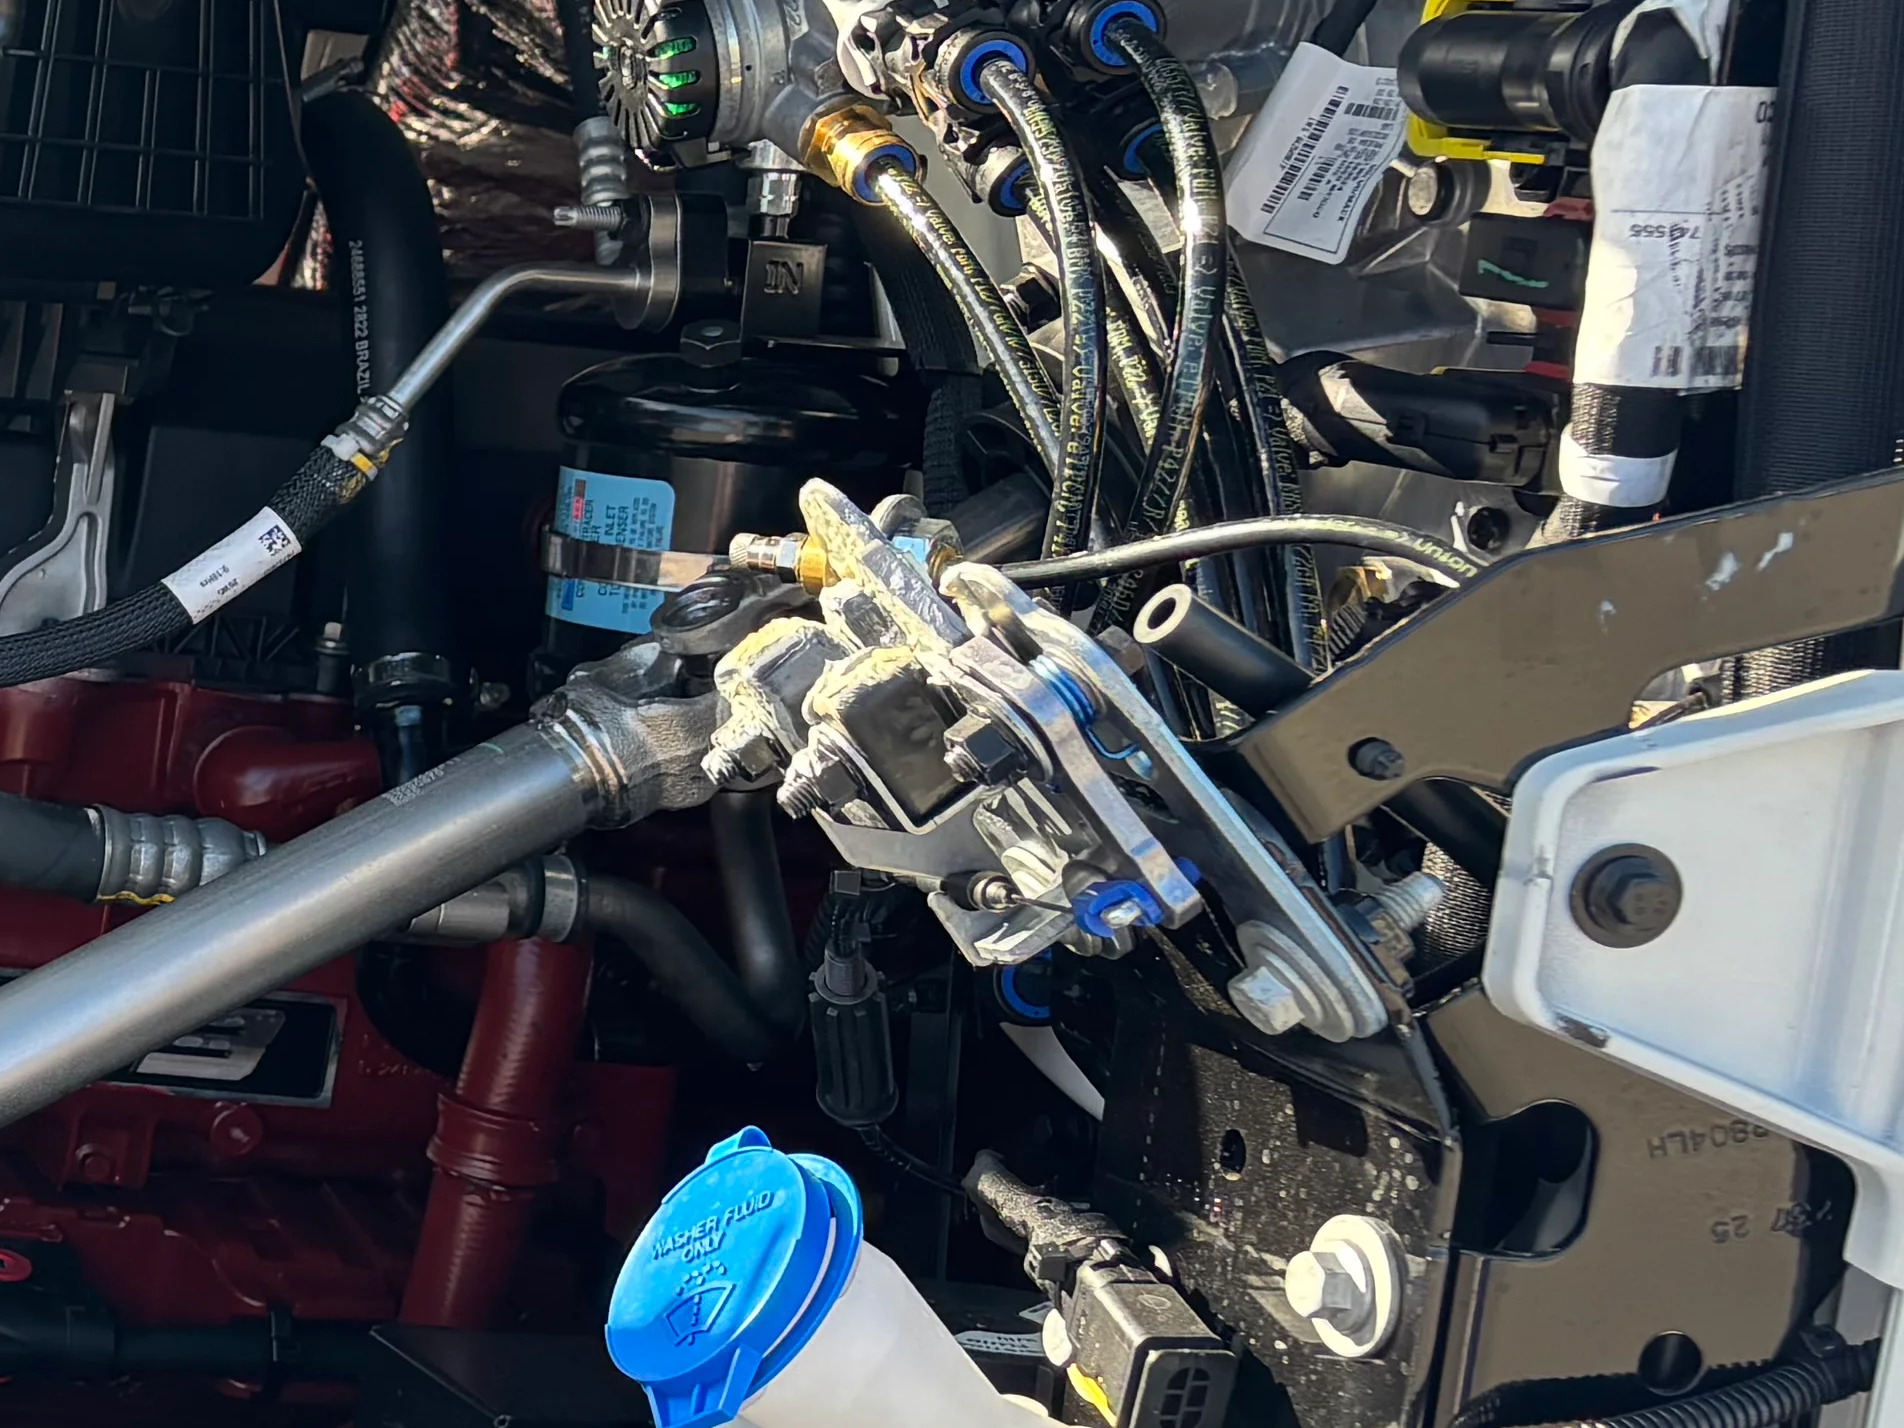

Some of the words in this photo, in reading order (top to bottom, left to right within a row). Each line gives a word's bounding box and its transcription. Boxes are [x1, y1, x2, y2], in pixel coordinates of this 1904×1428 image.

[765, 260, 804, 294] IN
[355, 340, 370, 394] BRAZIL
[653, 1216, 720, 1260] WASHER
[723, 1190, 774, 1227] FLUID
[682, 1230, 726, 1263] ONLY
